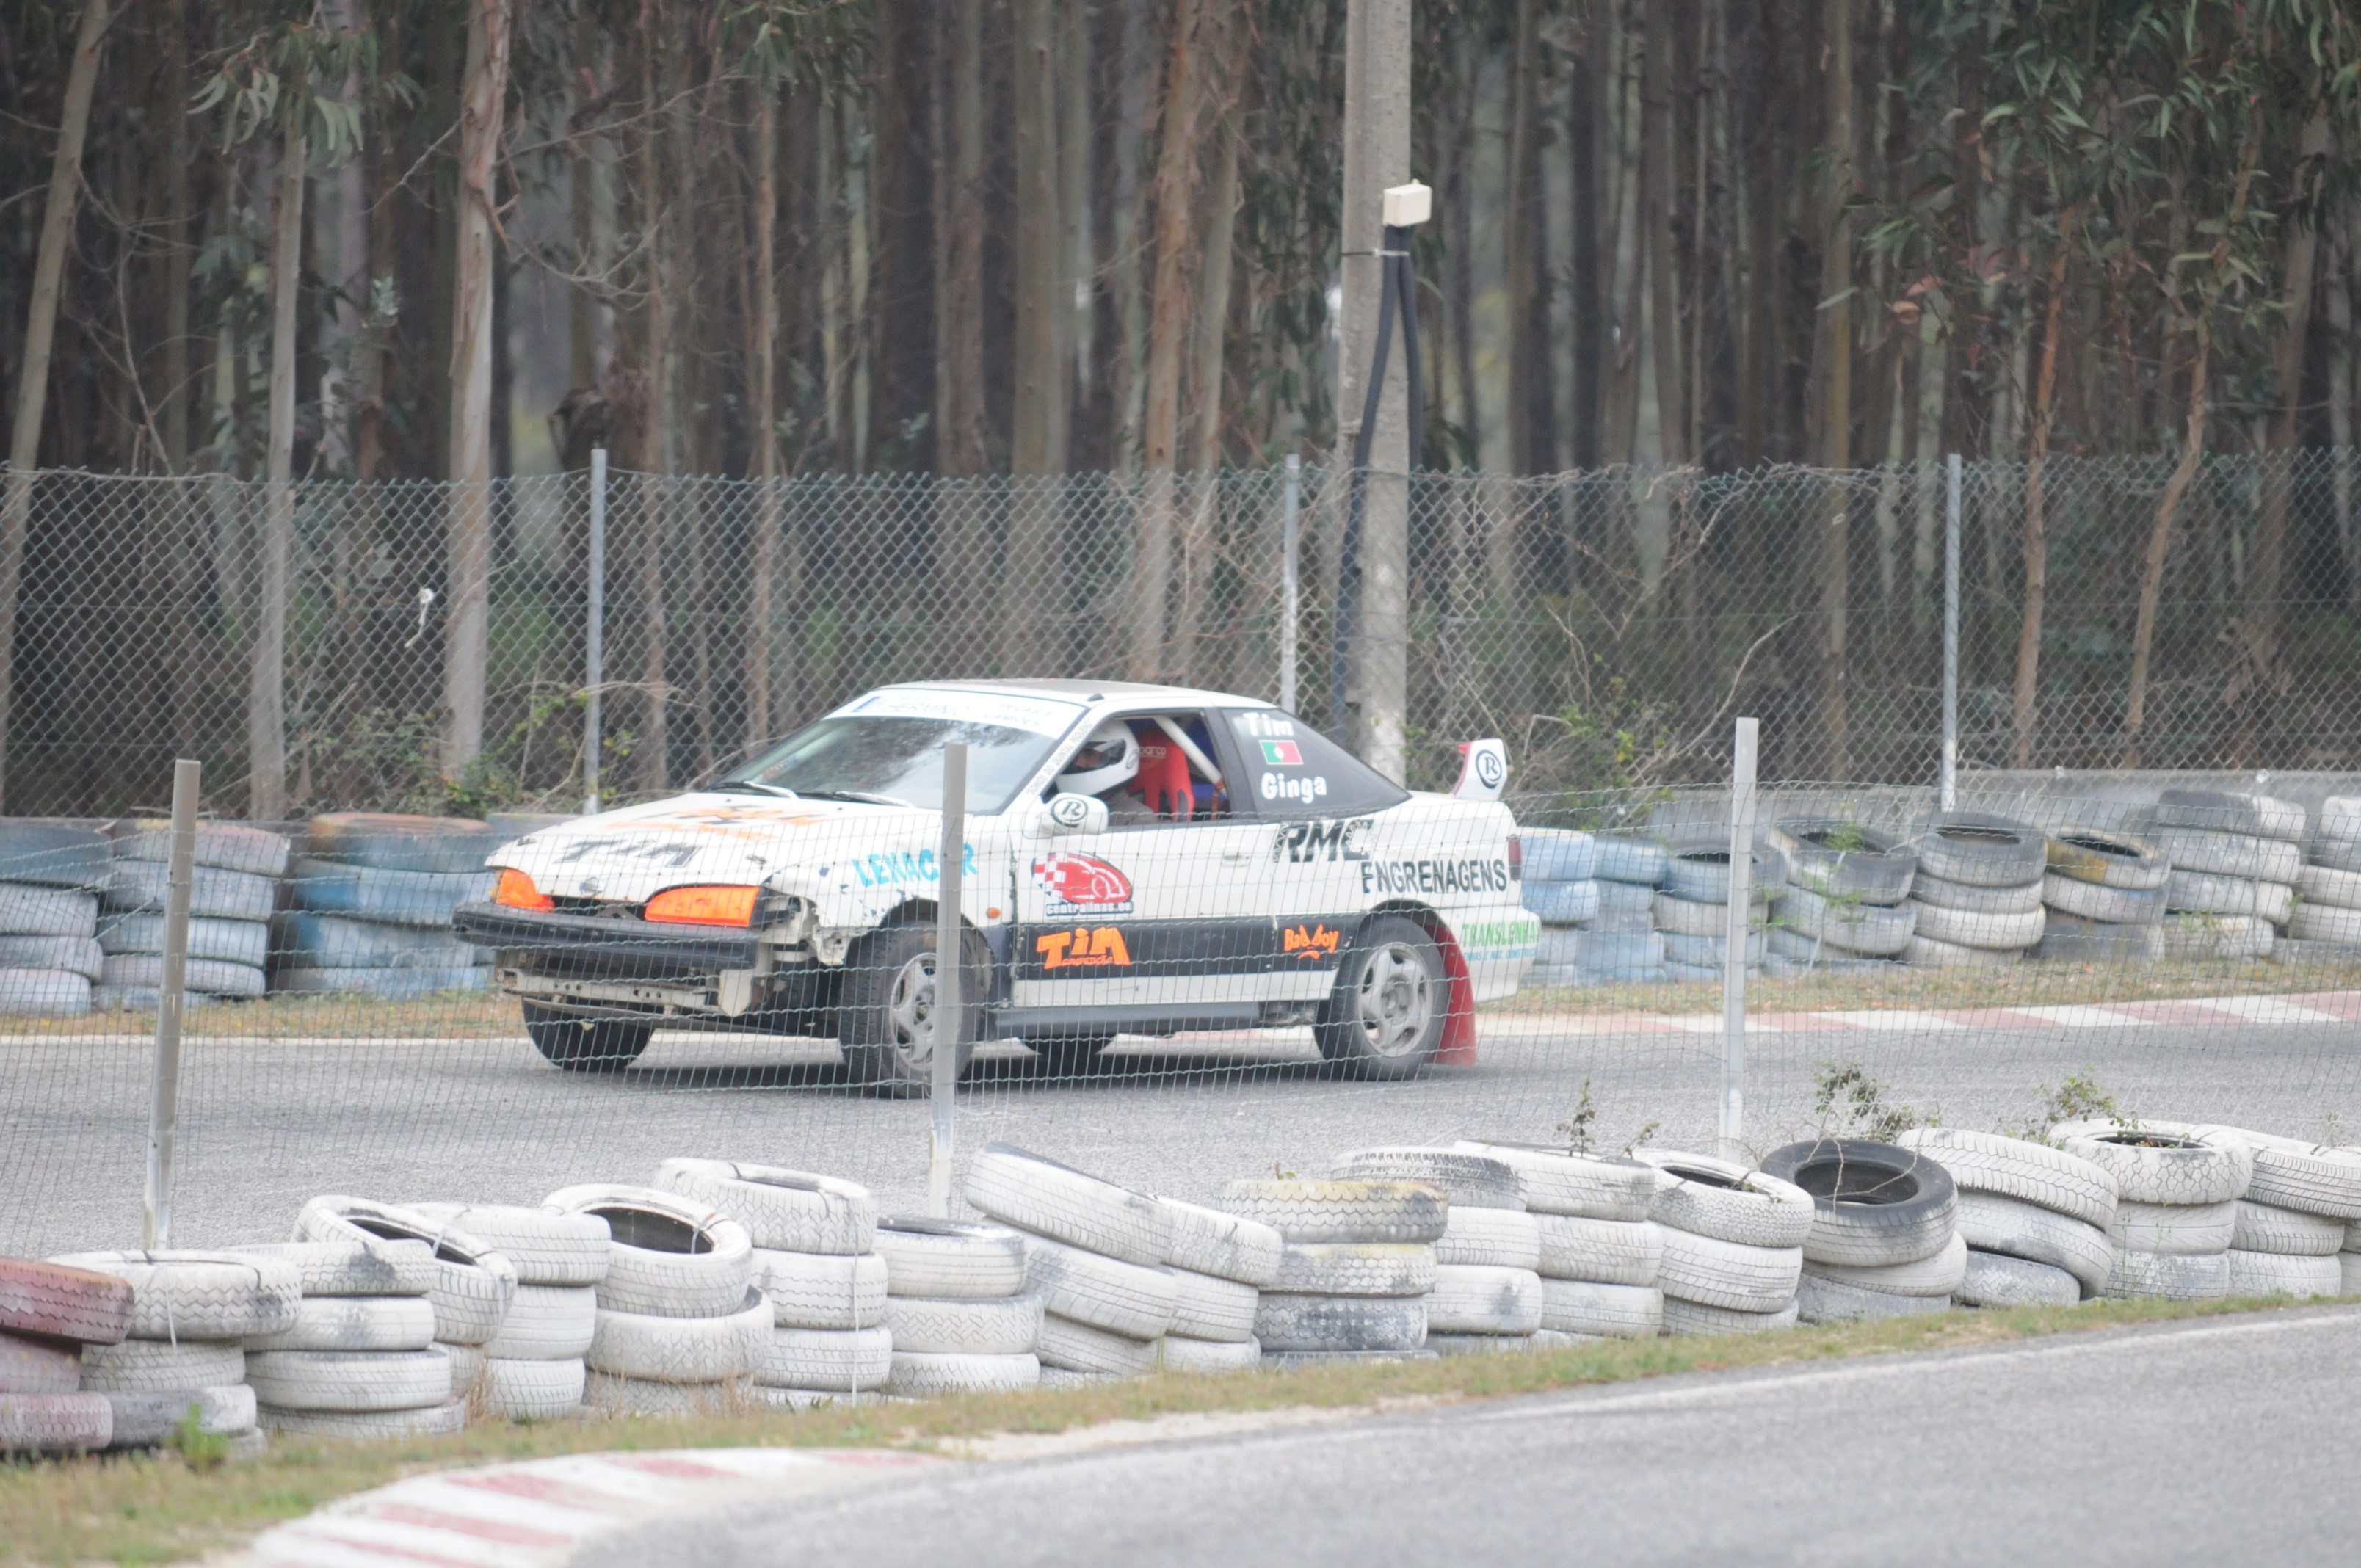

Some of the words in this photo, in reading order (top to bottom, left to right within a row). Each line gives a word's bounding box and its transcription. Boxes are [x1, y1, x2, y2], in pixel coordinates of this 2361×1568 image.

[1243, 712, 1294, 736] Tim
[1261, 772, 1327, 804] Ginga
[851, 843, 978, 888] LENACR
[1361, 859, 1506, 894] ENGRENAGENS
